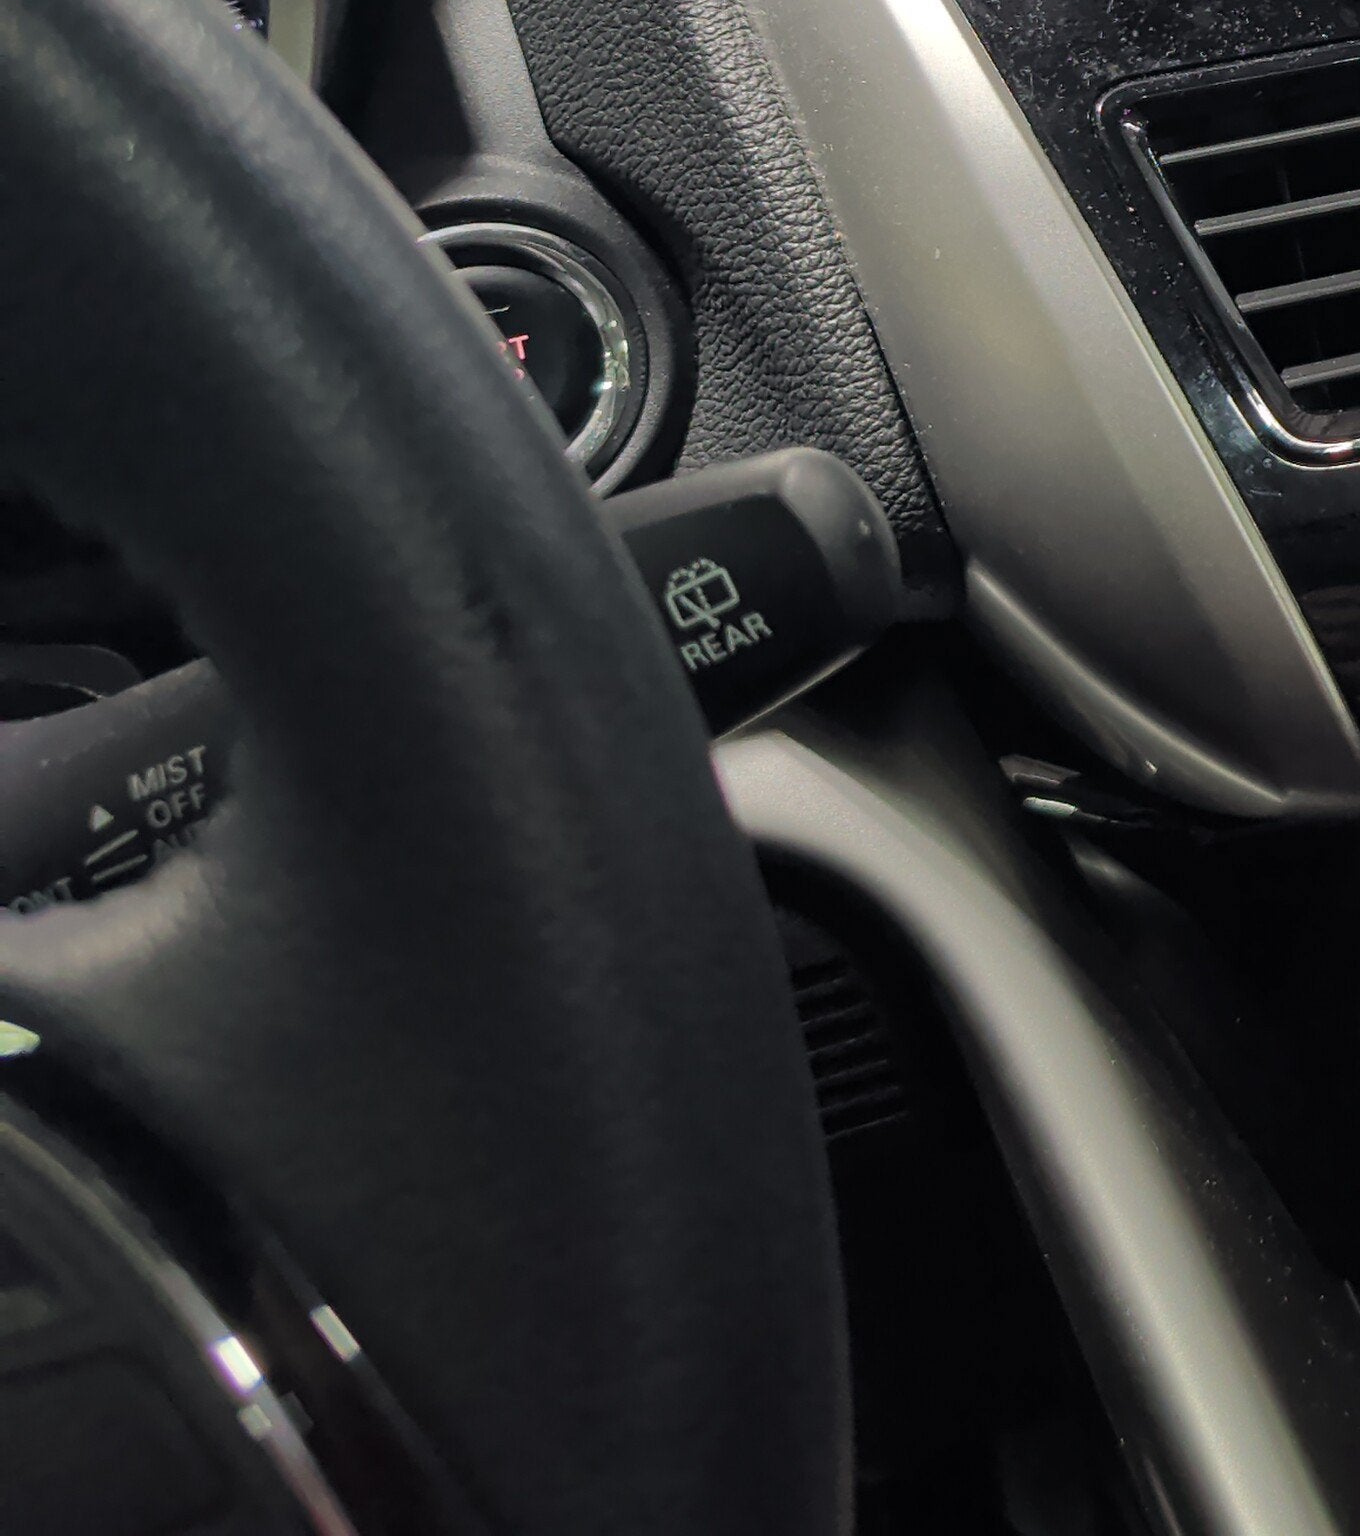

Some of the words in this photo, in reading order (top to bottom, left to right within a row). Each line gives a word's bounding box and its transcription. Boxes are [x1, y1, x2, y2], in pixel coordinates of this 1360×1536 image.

[680, 612, 774, 670] REAR
[127, 744, 207, 801] MIST
[147, 782, 205, 829] OFF
